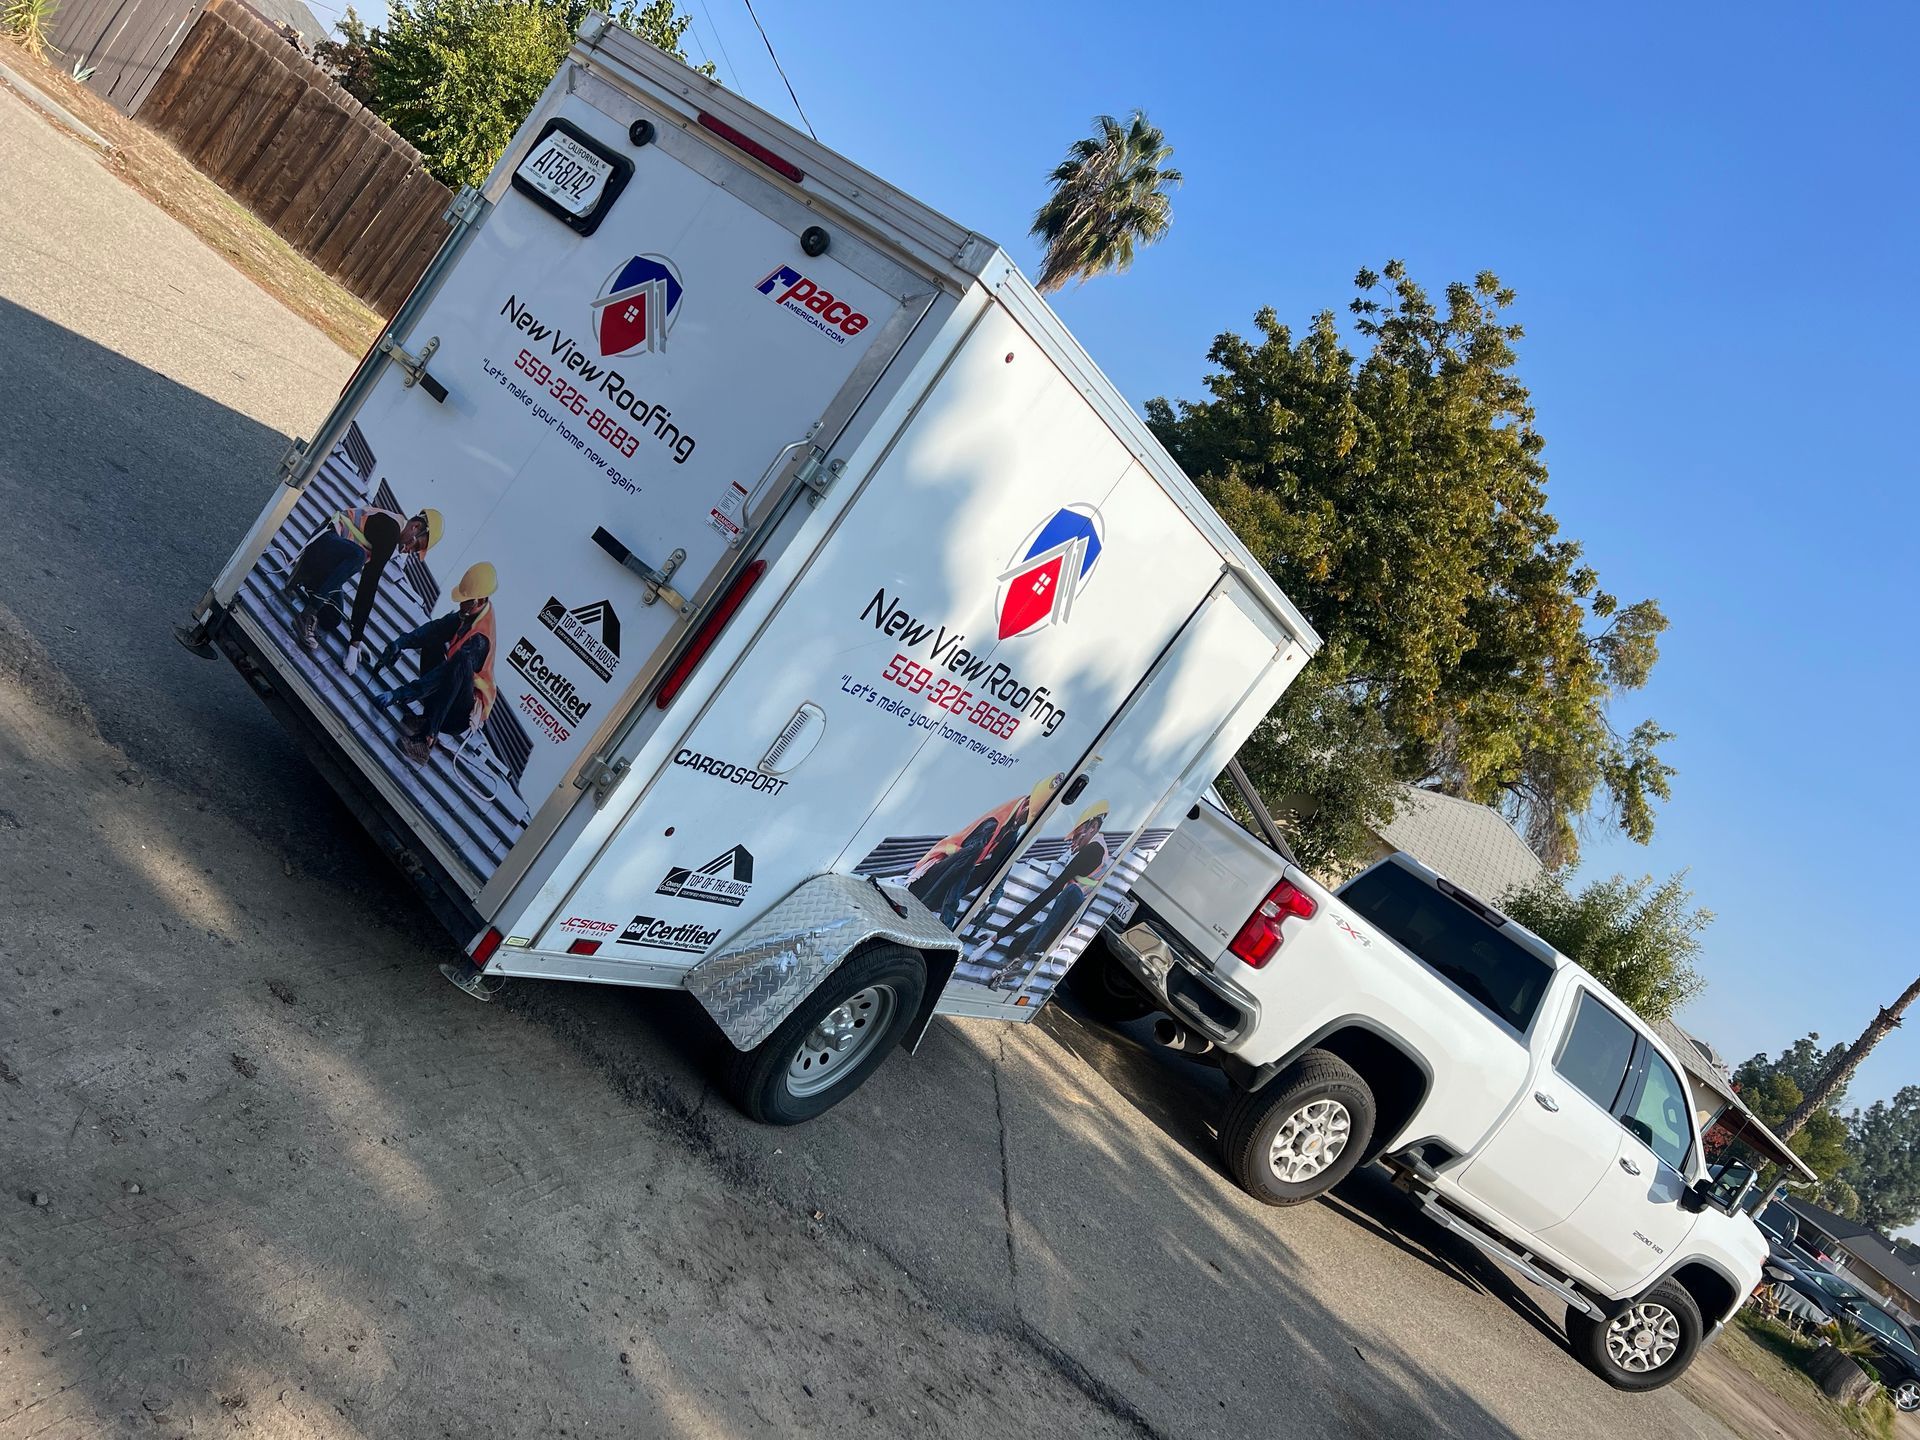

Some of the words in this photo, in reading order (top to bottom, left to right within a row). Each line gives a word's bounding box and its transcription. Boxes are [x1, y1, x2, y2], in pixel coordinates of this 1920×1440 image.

[532, 148, 596, 200] AT58Z42
[568, 142, 600, 168] CALIFORNIA
[776, 278, 868, 336] pace
[784, 301, 845, 344] AMERICAN.COM
[500, 295, 552, 342] New
[552, 330, 604, 382] View
[600, 371, 696, 464] Roofing
[514, 349, 640, 458] 559-326-8683
[507, 382, 532, 406] make
[532, 402, 557, 426] your
[556, 421, 584, 450] home
[584, 446, 608, 468] new
[606, 467, 642, 495] again"
[562, 614, 576, 630] TOP
[574, 626, 586, 640] OF
[582, 634, 598, 652] THE
[594, 646, 620, 672] HOUSE
[860, 588, 934, 646] New
[930, 626, 991, 682] View
[981, 663, 1066, 738] Roofing
[514, 644, 532, 660] GAF
[530, 654, 592, 720] Certified
[882, 654, 1020, 740] 559-326-8683
[876, 696, 911, 718] make
[908, 711, 939, 731] your
[937, 722, 967, 745] home
[967, 738, 990, 754] new
[988, 750, 1020, 768] again"
[674, 749, 788, 796] CARGOSPORT
[686, 874, 704, 887] TOP
[700, 878, 714, 889] OF
[711, 880, 728, 893] THE
[724, 882, 752, 896] HOUSE
[626, 922, 650, 934] GAF
[647, 920, 722, 946] Certified
[1212, 924, 1229, 939] LTZ
[1632, 1230, 1653, 1246] 2500
[1652, 1244, 1664, 1254] HD
